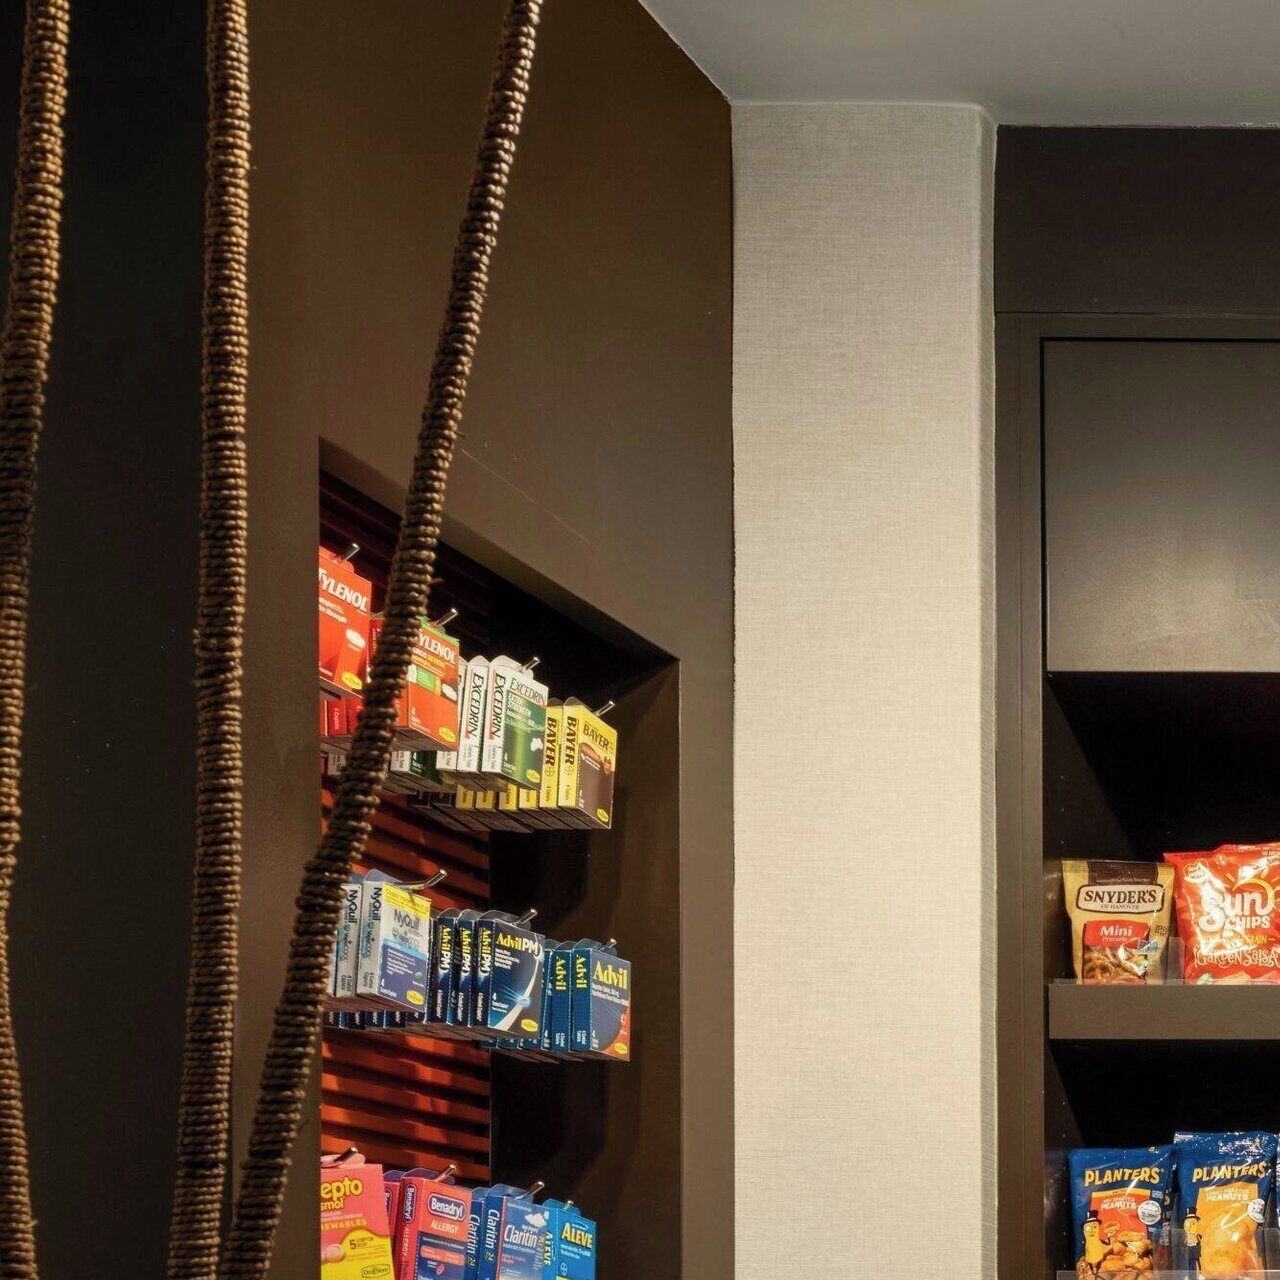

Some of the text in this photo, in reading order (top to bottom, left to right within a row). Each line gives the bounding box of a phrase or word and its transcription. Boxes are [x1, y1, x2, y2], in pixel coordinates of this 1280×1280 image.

[468, 673, 484, 738] EXCEDRIN
[494, 673, 507, 738] EXCEDRIN
[509, 678, 545, 706] EXCEDRIN
[545, 716, 558, 767] BAYER
[564, 716, 577, 767] BAYER
[583, 723, 610, 751] BAYER
[1084, 889, 1157, 904] SNYDER'S
[1100, 924, 1133, 937] Mini
[554, 955, 567, 991] Advil
[575, 953, 588, 989] Advil
[593, 958, 629, 990] Advil
[1084, 1166, 1161, 1187] PLANTERS
[1192, 1161, 1267, 1183] PLANTERS
[321, 1176, 363, 1201] epto
[405, 1187, 415, 1221] Benadryl
[431, 1197, 465, 1219] Benadryl
[431, 1219, 459, 1234] ALLERGY
[468, 1214, 481, 1256] Claritin
[486, 1209, 499, 1250] Claritin
[503, 1224, 538, 1249] Claritin
[562, 1222, 594, 1250] ALEVE
